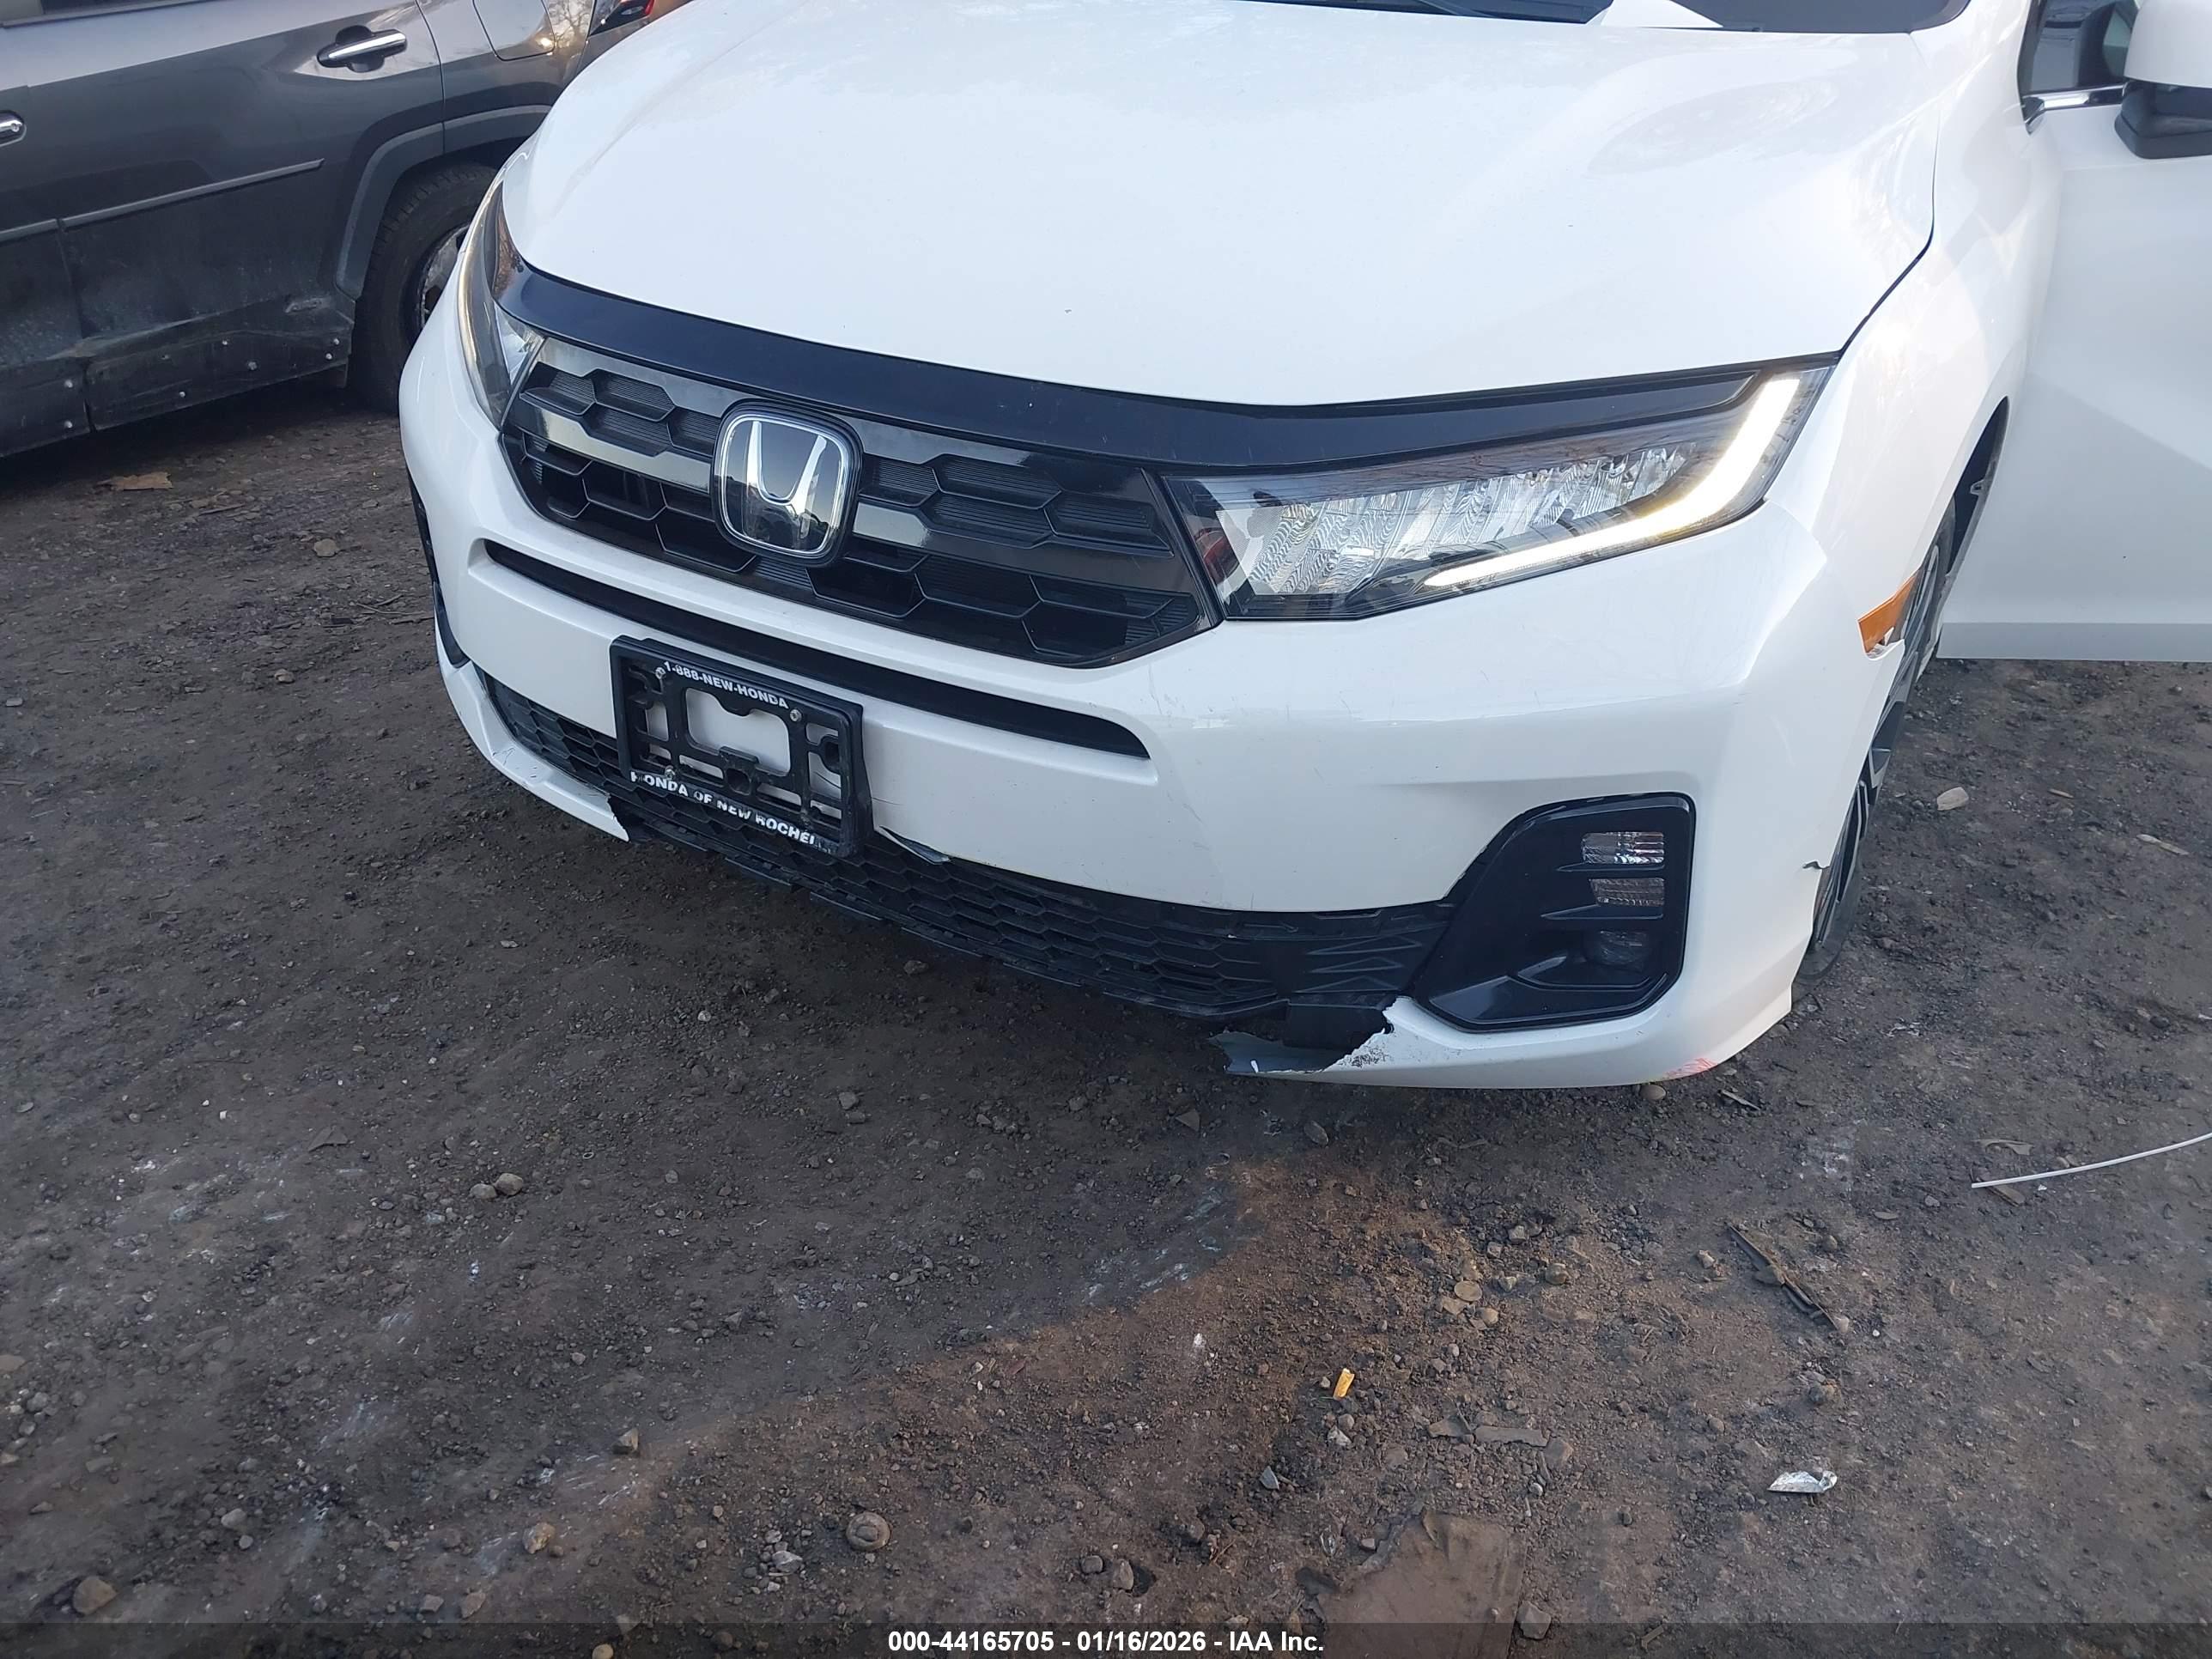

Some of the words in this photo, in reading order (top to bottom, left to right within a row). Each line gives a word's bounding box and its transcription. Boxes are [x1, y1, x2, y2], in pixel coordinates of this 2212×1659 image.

[664, 660, 789, 709] 1-888-NEW-HONDA
[630, 771, 689, 797] HONDA
[693, 791, 714, 804] OF
[716, 799, 752, 819] NEW
